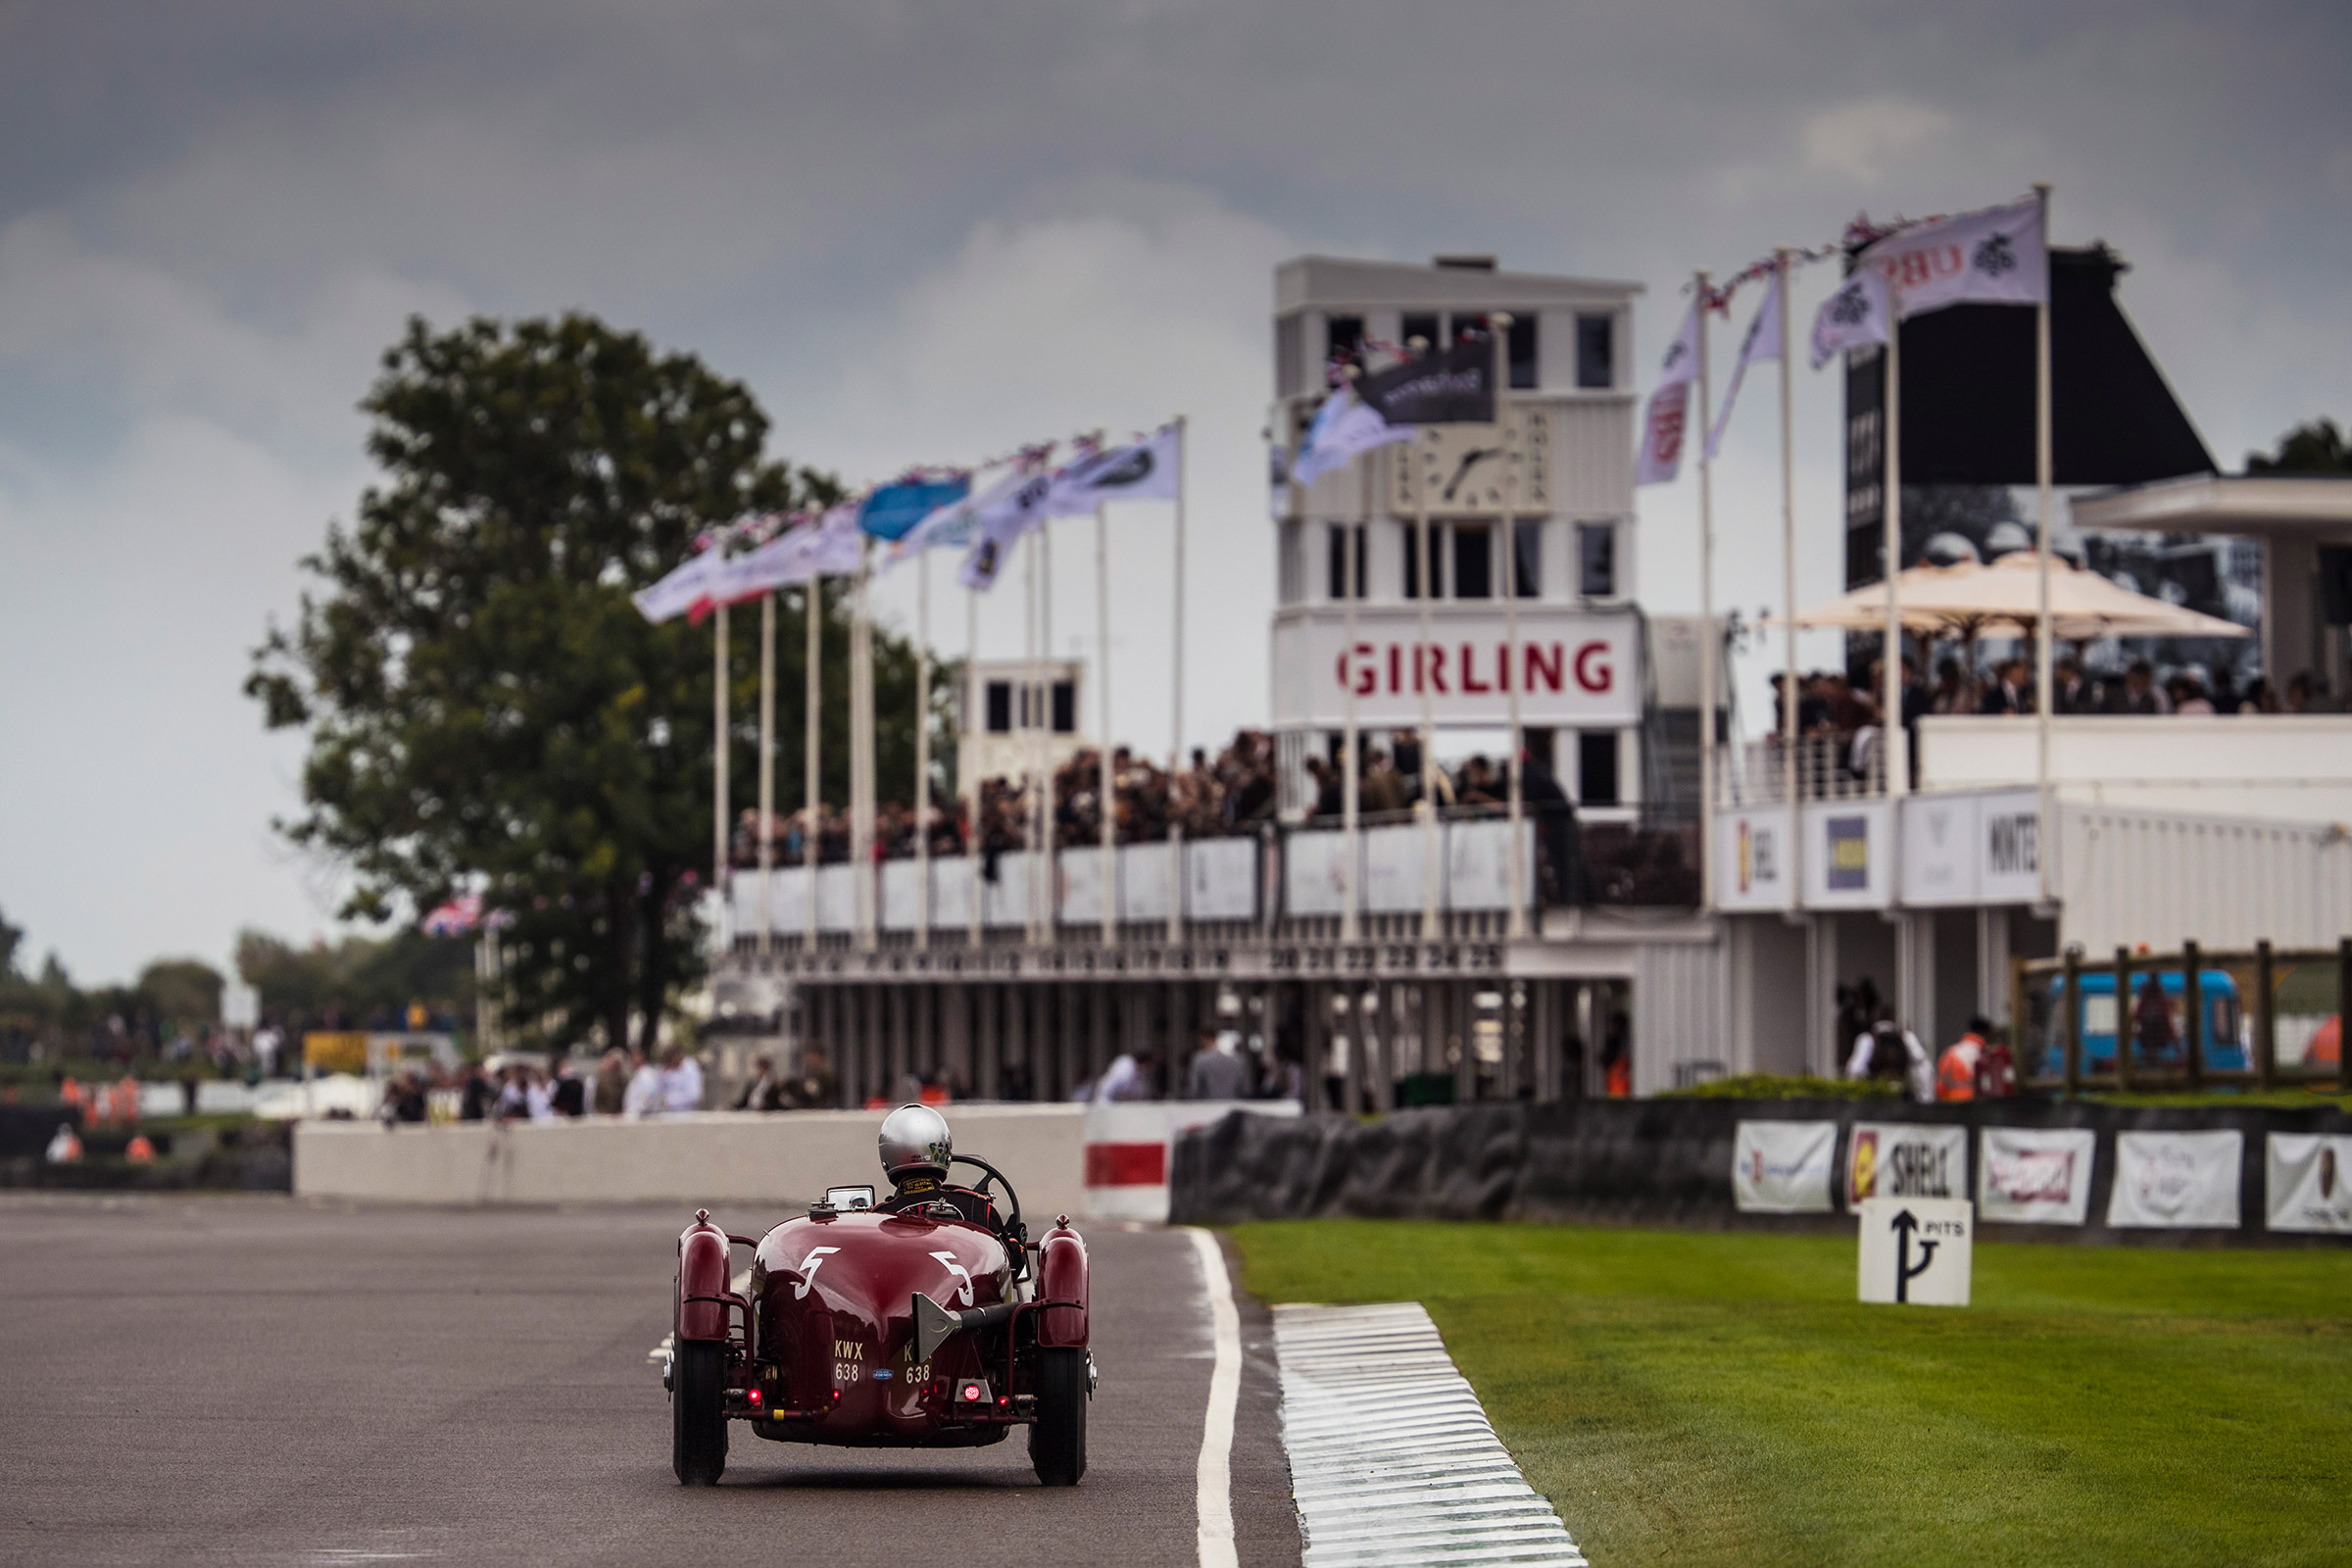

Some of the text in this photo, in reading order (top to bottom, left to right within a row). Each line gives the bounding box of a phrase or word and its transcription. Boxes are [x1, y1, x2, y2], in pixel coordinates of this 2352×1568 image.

[1335, 641, 1613, 695] GIRLING
[1892, 1142, 1949, 1197] SHELL
[1925, 1220, 1965, 1236] PITS
[789, 1247, 841, 1299] 5
[928, 1250, 975, 1307] 5
[835, 1340, 862, 1360] KWX
[835, 1362, 858, 1382] 638
[906, 1364, 930, 1384] 638
